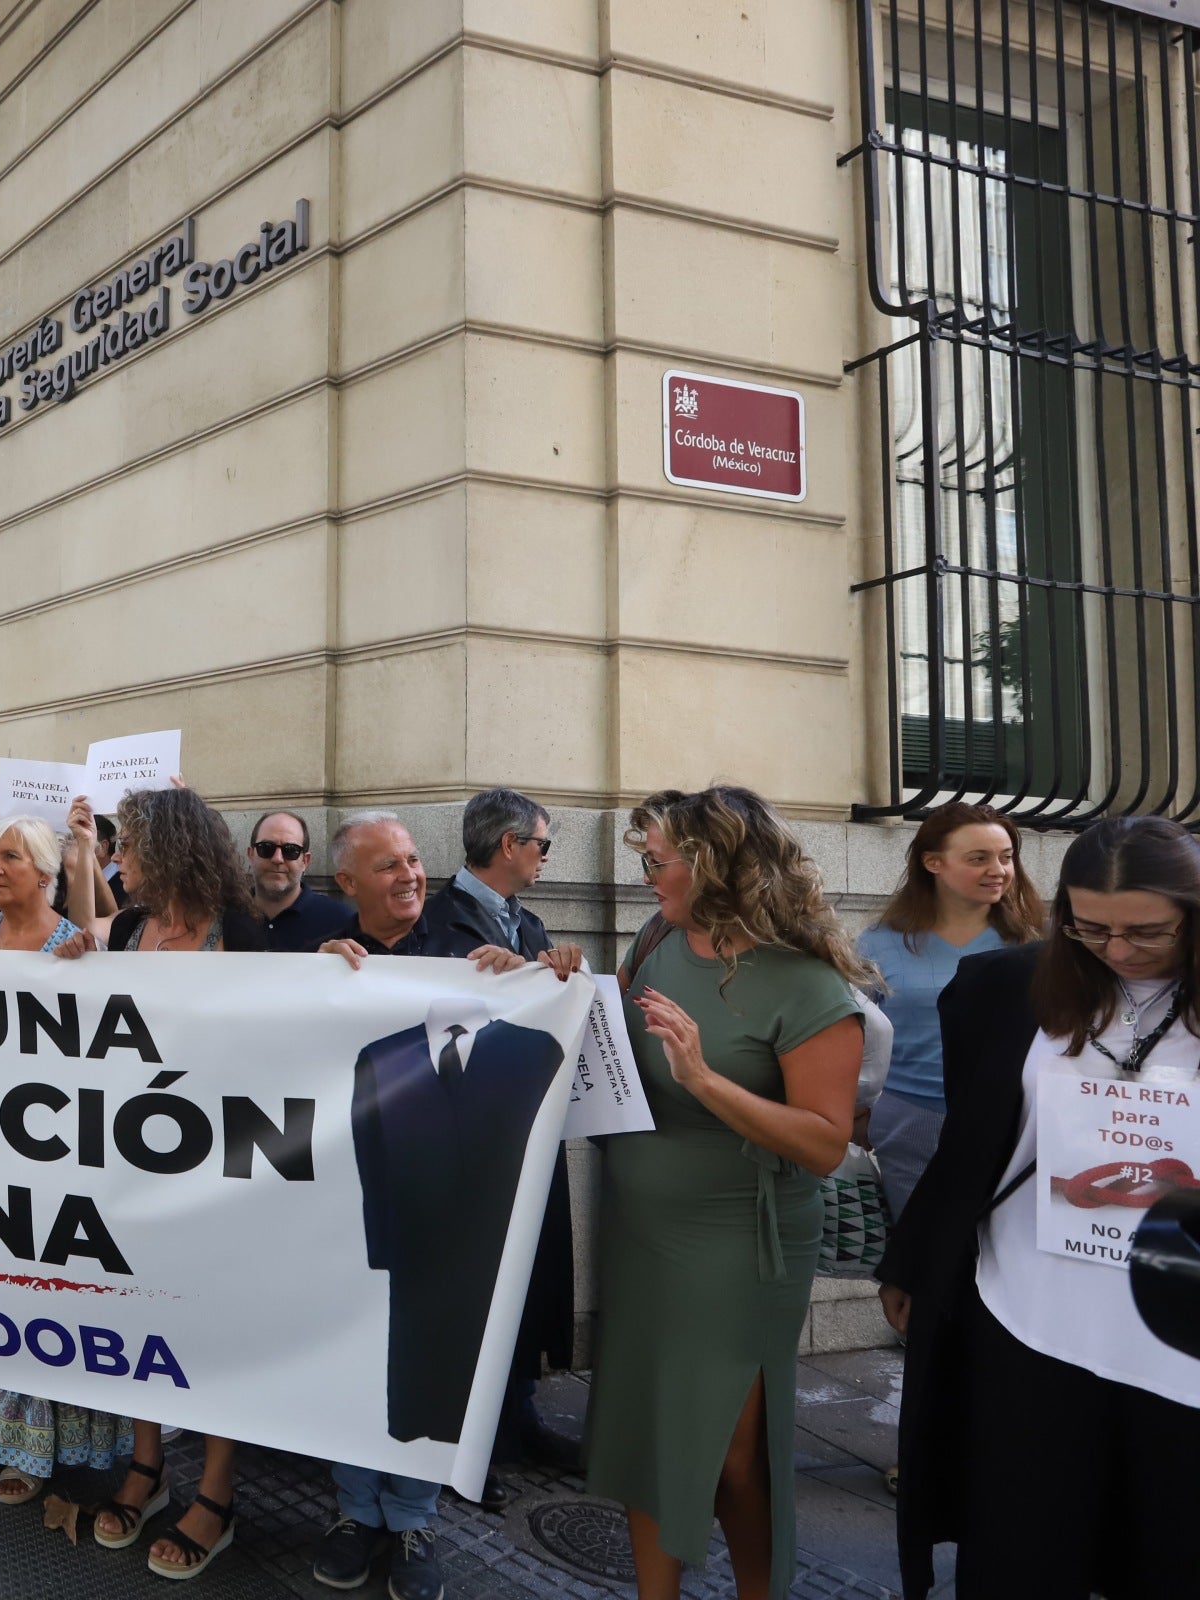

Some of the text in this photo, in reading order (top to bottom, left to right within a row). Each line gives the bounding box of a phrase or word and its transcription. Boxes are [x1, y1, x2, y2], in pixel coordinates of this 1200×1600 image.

[70, 217, 194, 334] General
[19, 286, 169, 411] Seguridad
[182, 198, 309, 314] Social
[675, 429, 796, 464] Córdoba de Veracruz
[713, 456, 761, 476] (México)
[100, 756, 158, 769] ¡PASARELA
[12, 779, 70, 792] ¡PASARELA
[100, 772, 128, 781] RETA
[12, 791, 40, 801] RETA
[594, 1000, 632, 1098] ¡PENSIONES DIGNAS!
[600, 1050, 607, 1063] AL
[604, 1064, 618, 1089] RETA
[614, 1090, 624, 1106] YA!
[1080, 1082, 1190, 1107] SI AL RETA
[1112, 1110, 1160, 1126] para
[1098, 1129, 1173, 1151] TOD@s
[1120, 1166, 1153, 1183] #J2
[1091, 1223, 1121, 1239] NO
